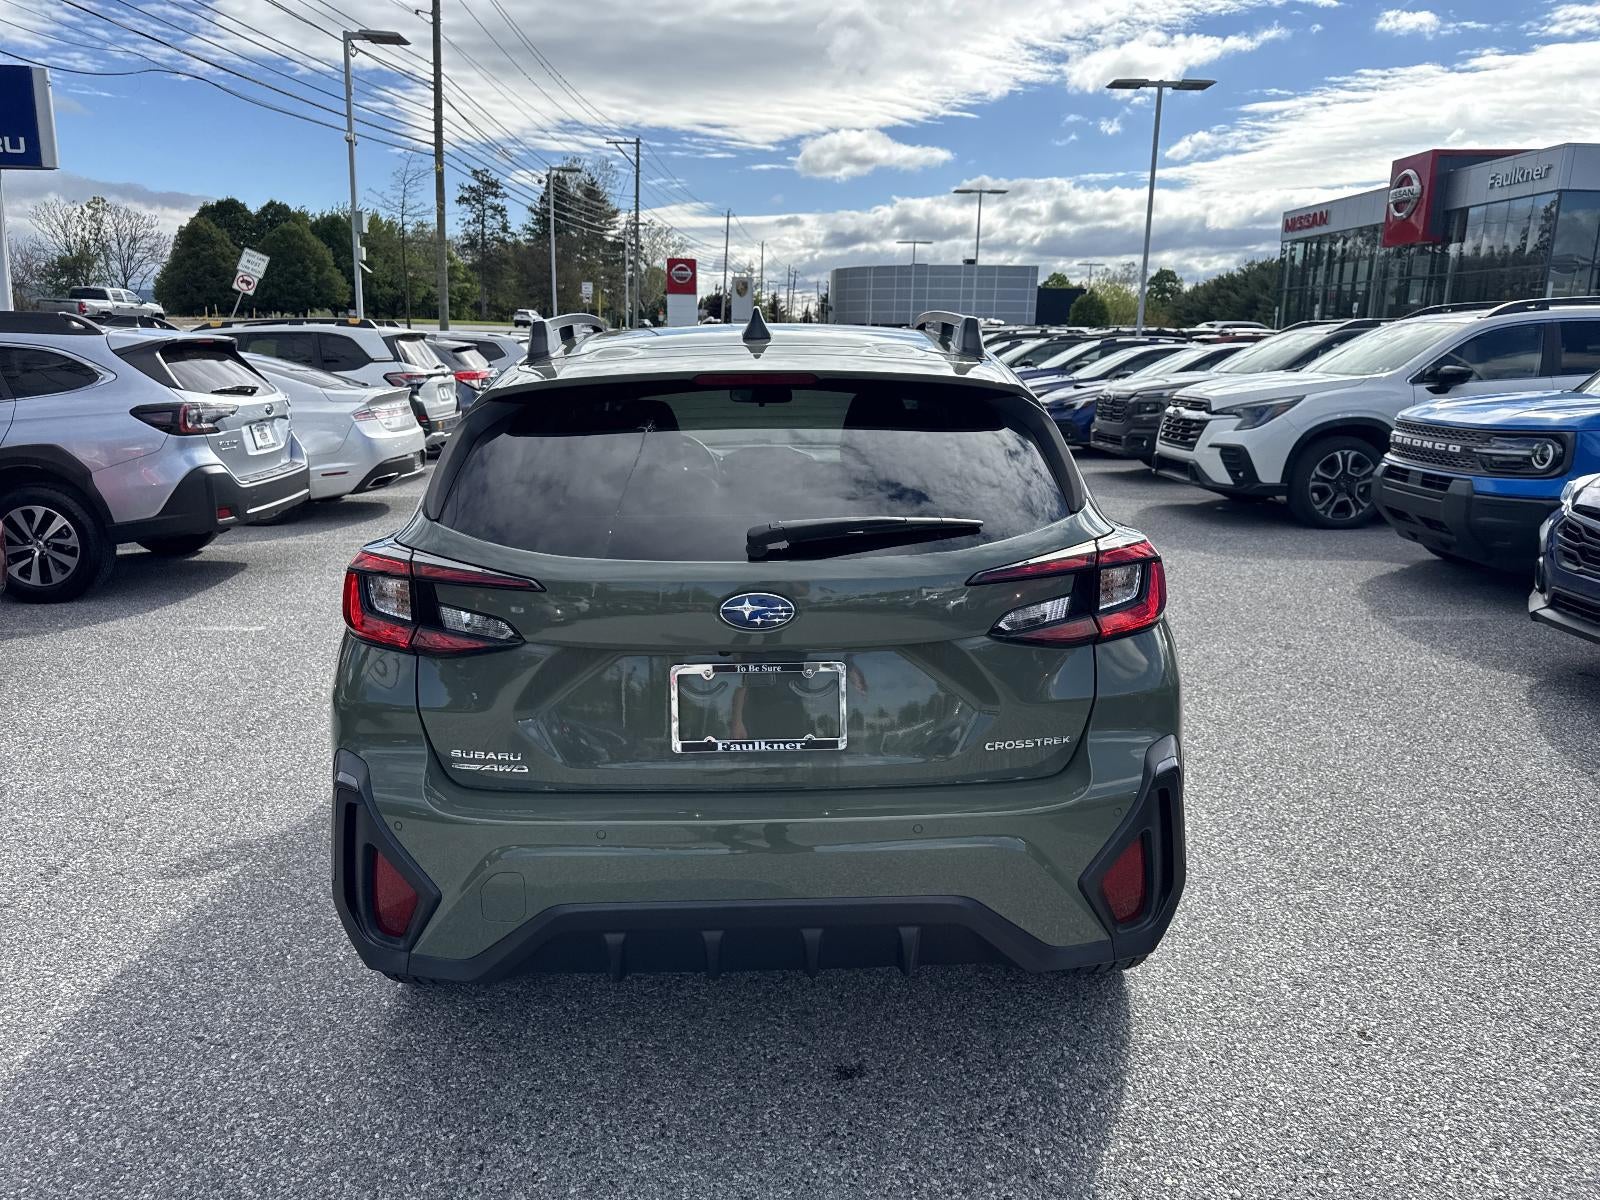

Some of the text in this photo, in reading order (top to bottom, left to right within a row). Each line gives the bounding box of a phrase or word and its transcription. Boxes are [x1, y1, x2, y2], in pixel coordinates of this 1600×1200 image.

[0, 136, 26, 153] U
[1488, 164, 1550, 189] Faulkner
[1284, 209, 1329, 233] NISSAN
[1395, 436, 1461, 453] BRONCO
[735, 664, 782, 673] To Be Sure
[717, 741, 806, 751] Faulkner
[985, 735, 1071, 751] CROSSTREK
[450, 749, 522, 761] SUBARU
[480, 763, 529, 773] AWD
